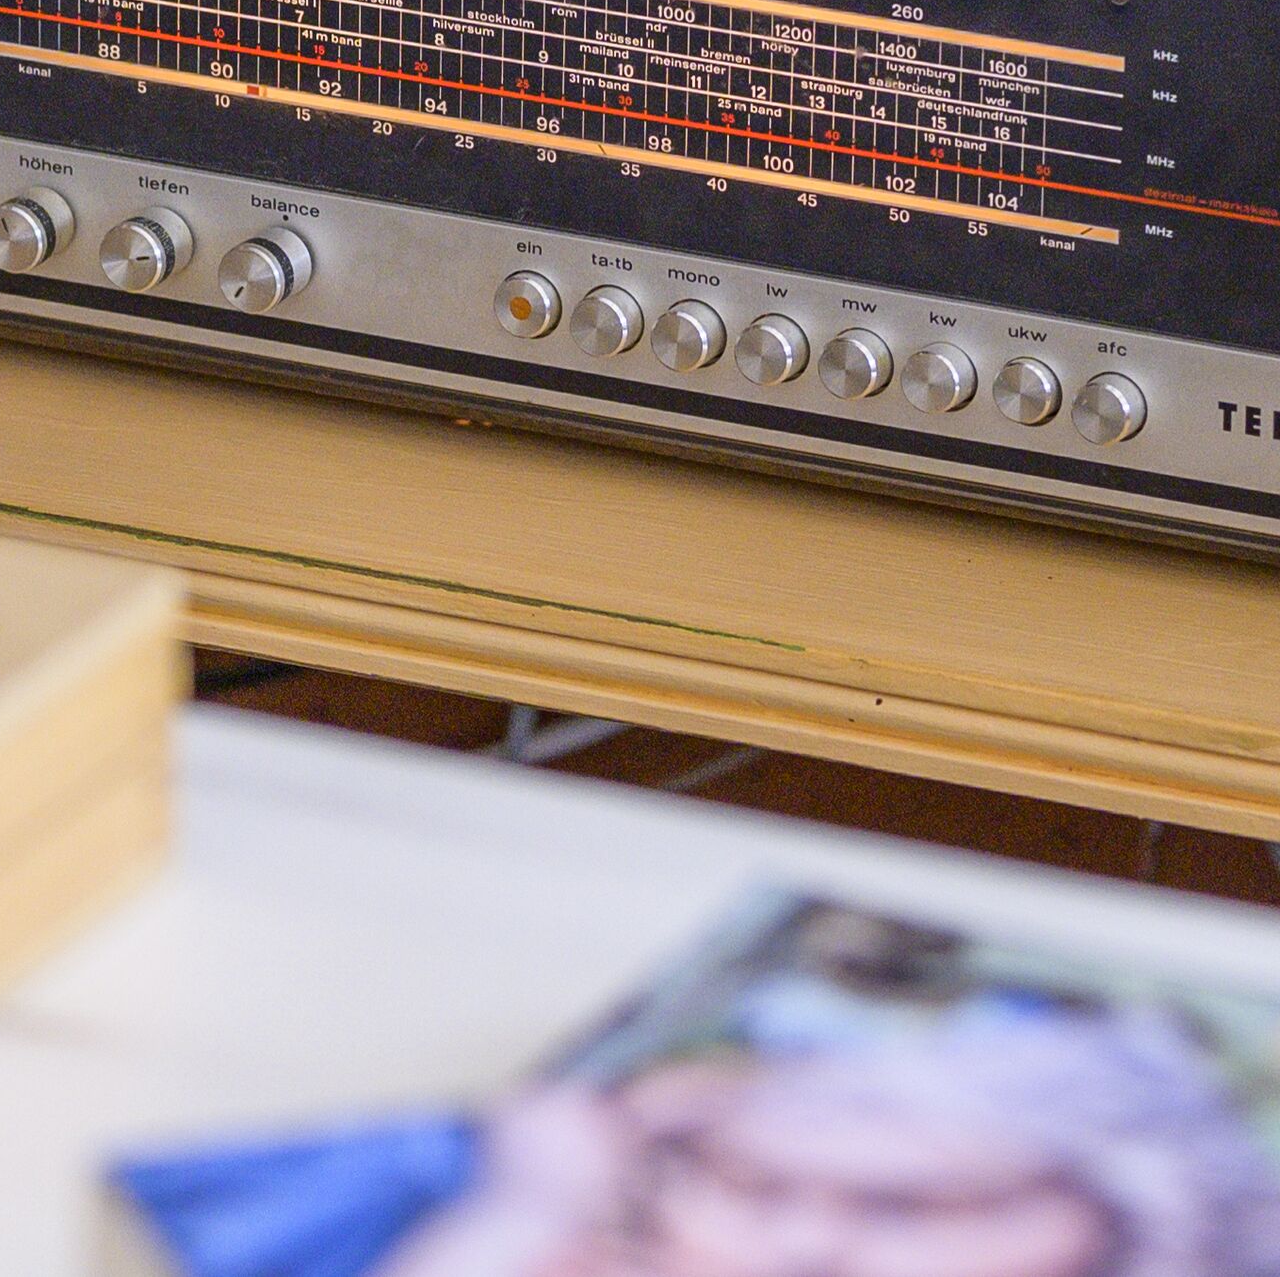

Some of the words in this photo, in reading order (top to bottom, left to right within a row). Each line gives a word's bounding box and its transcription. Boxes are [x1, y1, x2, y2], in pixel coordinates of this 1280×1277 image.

[113, 0, 144, 12] band
[551, 6, 578, 19] rom
[892, 4, 923, 21] 260
[467, 9, 534, 29] stockholm
[646, 21, 668, 34] ndr
[432, 18, 495, 38] hilversum
[329, 34, 362, 48] band
[595, 31, 643, 47] brüssel
[658, 5, 695, 23] 1000
[775, 24, 811, 42] 1200
[879, 42, 916, 59] 1400
[990, 60, 1027, 77] 1600
[580, 44, 629, 60] mailand
[701, 48, 750, 65] bremen
[1154, 49, 1179, 63] kHz
[650, 54, 727, 76] rheinsender
[886, 61, 956, 83] luxemburg
[296, 10, 304, 24] 7
[434, 33, 444, 46] 8
[538, 50, 548, 63] 9
[618, 63, 634, 77] 10
[690, 76, 701, 88] 11
[750, 84, 766, 99] 12
[809, 95, 825, 110] 13
[870, 105, 886, 119] 14
[931, 115, 947, 129] 15
[994, 126, 1010, 141] 16
[569, 72, 581, 85] 31
[584, 77, 596, 85] m
[600, 78, 630, 93] band
[979, 76, 1040, 95] münchen
[986, 95, 1011, 108] wdr
[1152, 89, 1177, 104] kHz
[717, 98, 731, 110] 25
[751, 102, 782, 118] band
[917, 99, 1028, 126] deutschlandfunk
[98, 43, 120, 60] 88
[211, 62, 233, 79] 90
[319, 81, 341, 97] 92
[425, 98, 448, 115] 94
[537, 117, 559, 134] 96
[648, 135, 672, 152] 98
[764, 155, 794, 174] 100
[886, 176, 916, 194] 102
[988, 192, 1018, 211] 104
[924, 132, 936, 145] 19
[940, 136, 951, 145] m
[956, 137, 987, 152] band
[19, 64, 52, 79] kanal
[138, 81, 147, 94] 5
[216, 94, 230, 108] 10
[296, 108, 311, 122] 15
[373, 121, 393, 136] 20
[455, 134, 474, 149] 25
[537, 149, 557, 164] 30
[621, 162, 640, 177] 35
[707, 177, 727, 192] 40
[797, 192, 817, 208] 45
[889, 208, 910, 223] 50
[968, 222, 988, 237] 55
[1040, 236, 1075, 252] kanal
[20, 155, 74, 176] höhen
[1147, 154, 1176, 169] MHz
[138, 175, 190, 196] tiefen
[251, 194, 320, 218] balance
[1145, 224, 1174, 239] MHz
[516, 240, 542, 255] ein
[591, 253, 632, 271] ta-tb
[668, 266, 720, 286] mono
[842, 298, 877, 313] mw
[929, 312, 957, 327] kw
[1008, 326, 1047, 342] ukw
[1098, 341, 1127, 356] afc
